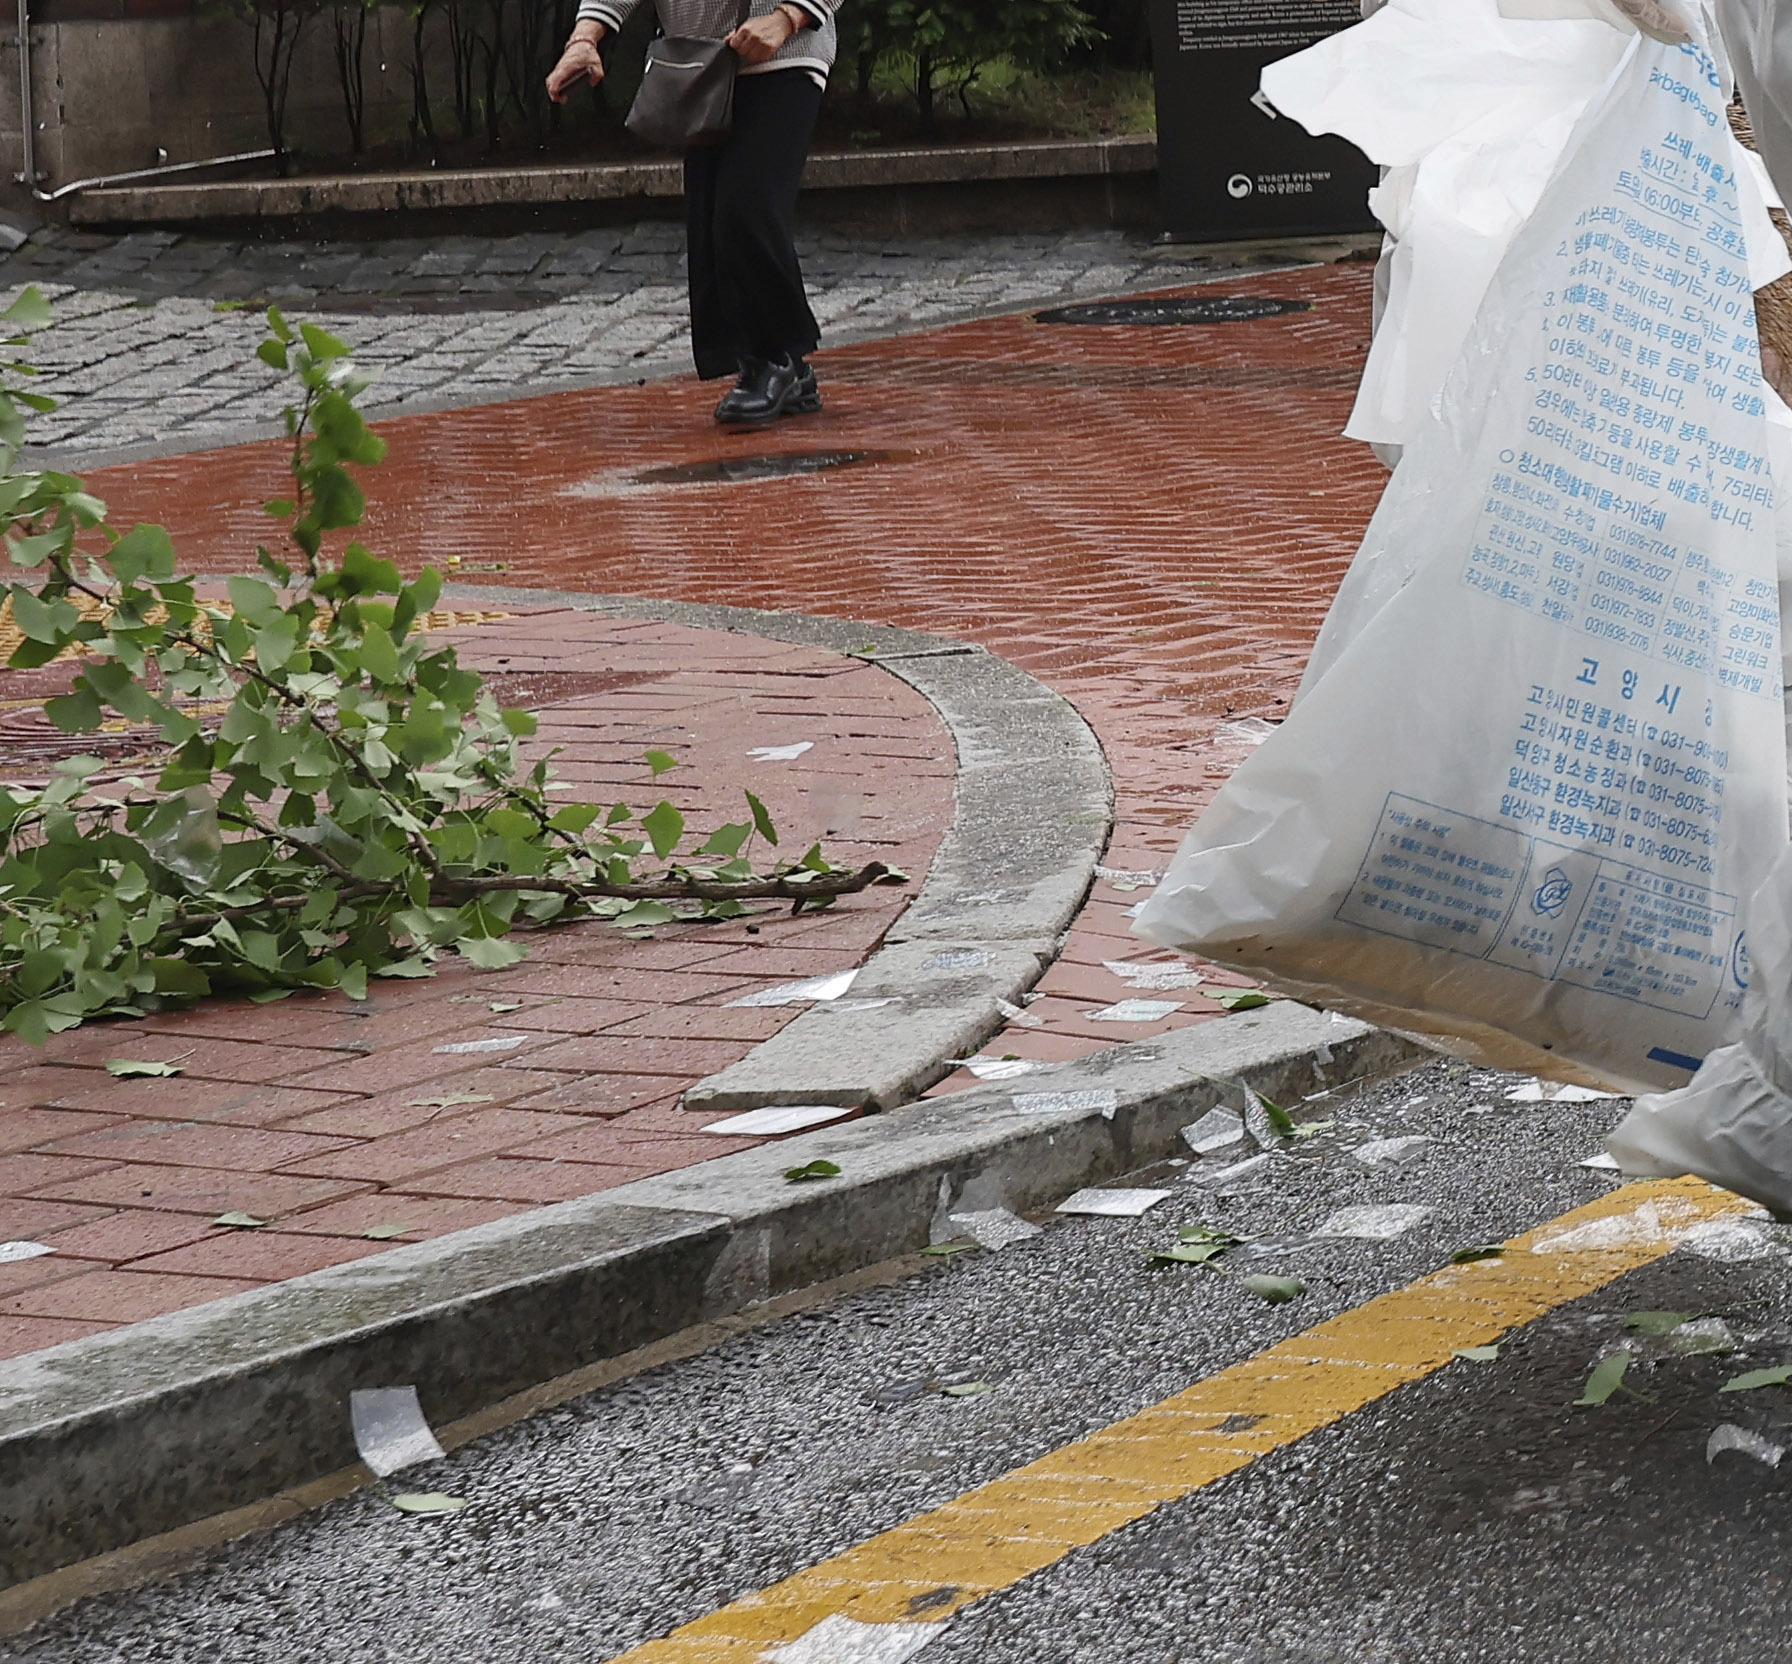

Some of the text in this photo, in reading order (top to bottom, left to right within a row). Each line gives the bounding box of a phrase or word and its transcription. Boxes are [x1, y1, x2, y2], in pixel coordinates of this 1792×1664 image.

[1654, 322, 1703, 356] 투명한
[1735, 362, 1764, 388] 또는
[1634, 435, 1681, 467] 사용할
[1552, 751, 1630, 793] 청소농정과
[1554, 780, 1623, 820] 환경녹지과
[1547, 808, 1617, 848] 환경녹지과
